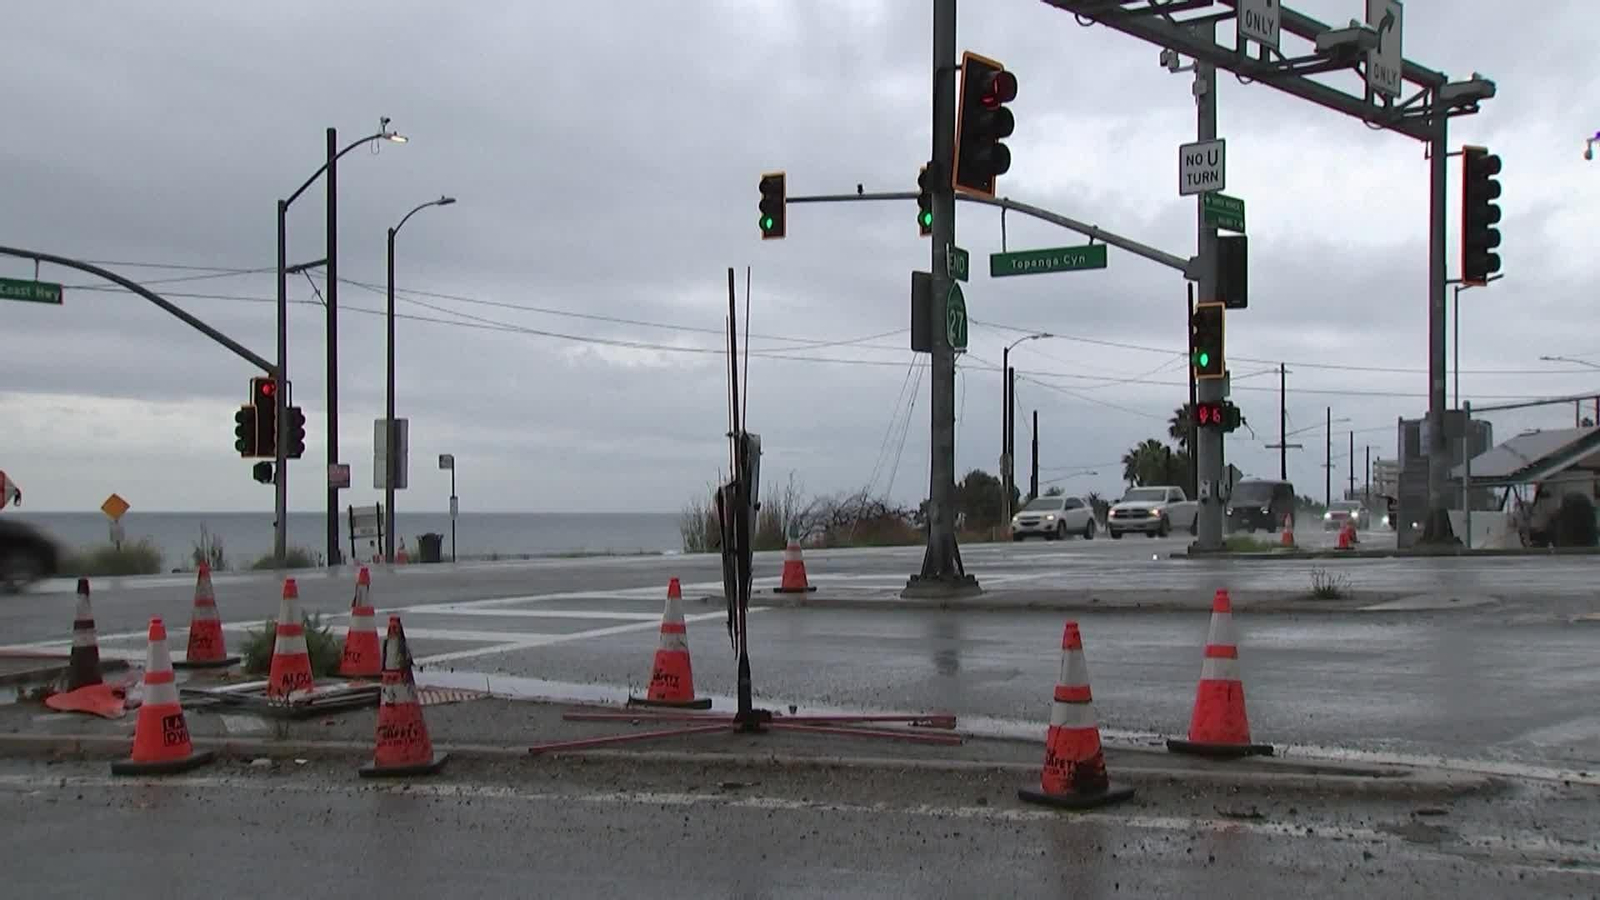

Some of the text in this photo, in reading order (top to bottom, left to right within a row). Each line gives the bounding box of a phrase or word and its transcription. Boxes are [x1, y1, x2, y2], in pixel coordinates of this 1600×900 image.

[1245, 9, 1274, 36] ONLY
[1373, 63, 1397, 84] ONLY
[1186, 148, 1218, 167] NO U
[1187, 170, 1218, 186] TURN
[950, 252, 965, 274] END
[1011, 254, 1086, 270] Topanga Cyn
[0, 283, 60, 301] Coast Hwy
[950, 310, 964, 343] 27
